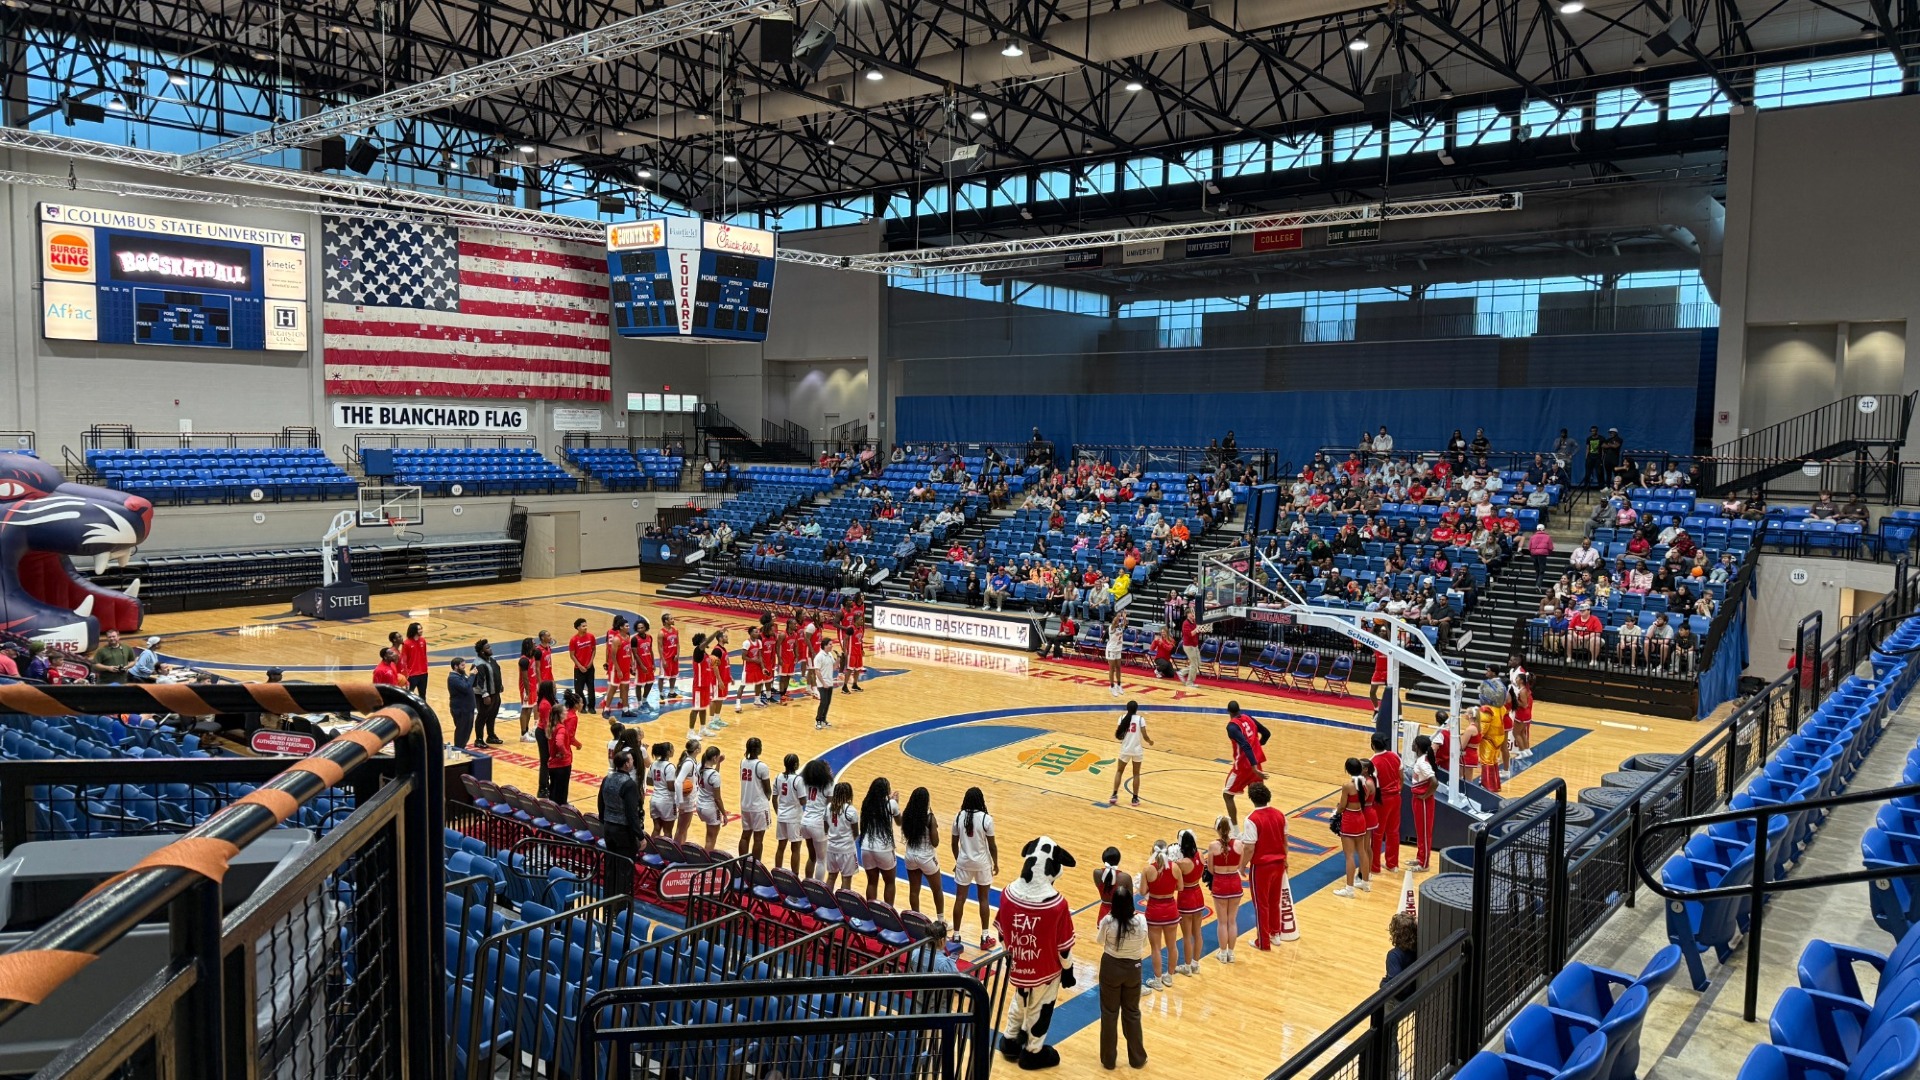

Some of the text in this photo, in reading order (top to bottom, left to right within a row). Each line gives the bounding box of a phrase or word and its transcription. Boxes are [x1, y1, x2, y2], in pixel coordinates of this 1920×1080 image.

[67, 208, 285, 244] COLUMBUS STATE UNIVERSITY
[669, 227, 698, 236] Fairfield
[1260, 233, 1295, 244] COLLEGE
[1328, 231, 1344, 241] STATE
[50, 244, 88, 256] BURGER
[1126, 247, 1160, 257] UNIVERSITY
[1187, 240, 1230, 252] UNIVERSITY
[50, 252, 89, 266] KING
[266, 259, 296, 270] kinetic
[701, 274, 718, 282] HOME
[680, 253, 690, 330] COUGARS
[47, 303, 93, 320] Aflac
[278, 311, 294, 326] H
[1862, 401, 1874, 409] 217
[341, 405, 522, 428] THE BLANCHARD FLAG
[330, 595, 366, 608] STIFEL
[1251, 611, 1292, 625] COUGARS
[890, 613, 1011, 640] COUGAR BASKETBALL
[1347, 629, 1380, 649] Schelde
[257, 738, 310, 749] AUTHORIZED PERSONNEL
[653, 769, 661, 782] 12
[741, 767, 752, 781] 22
[782, 783, 788, 796] 5
[666, 878, 698, 887] AUTHORIZD
[1012, 912, 1041, 933] EAT
[1010, 930, 1037, 949] MOR
[1008, 944, 1042, 961] CHIKIN
